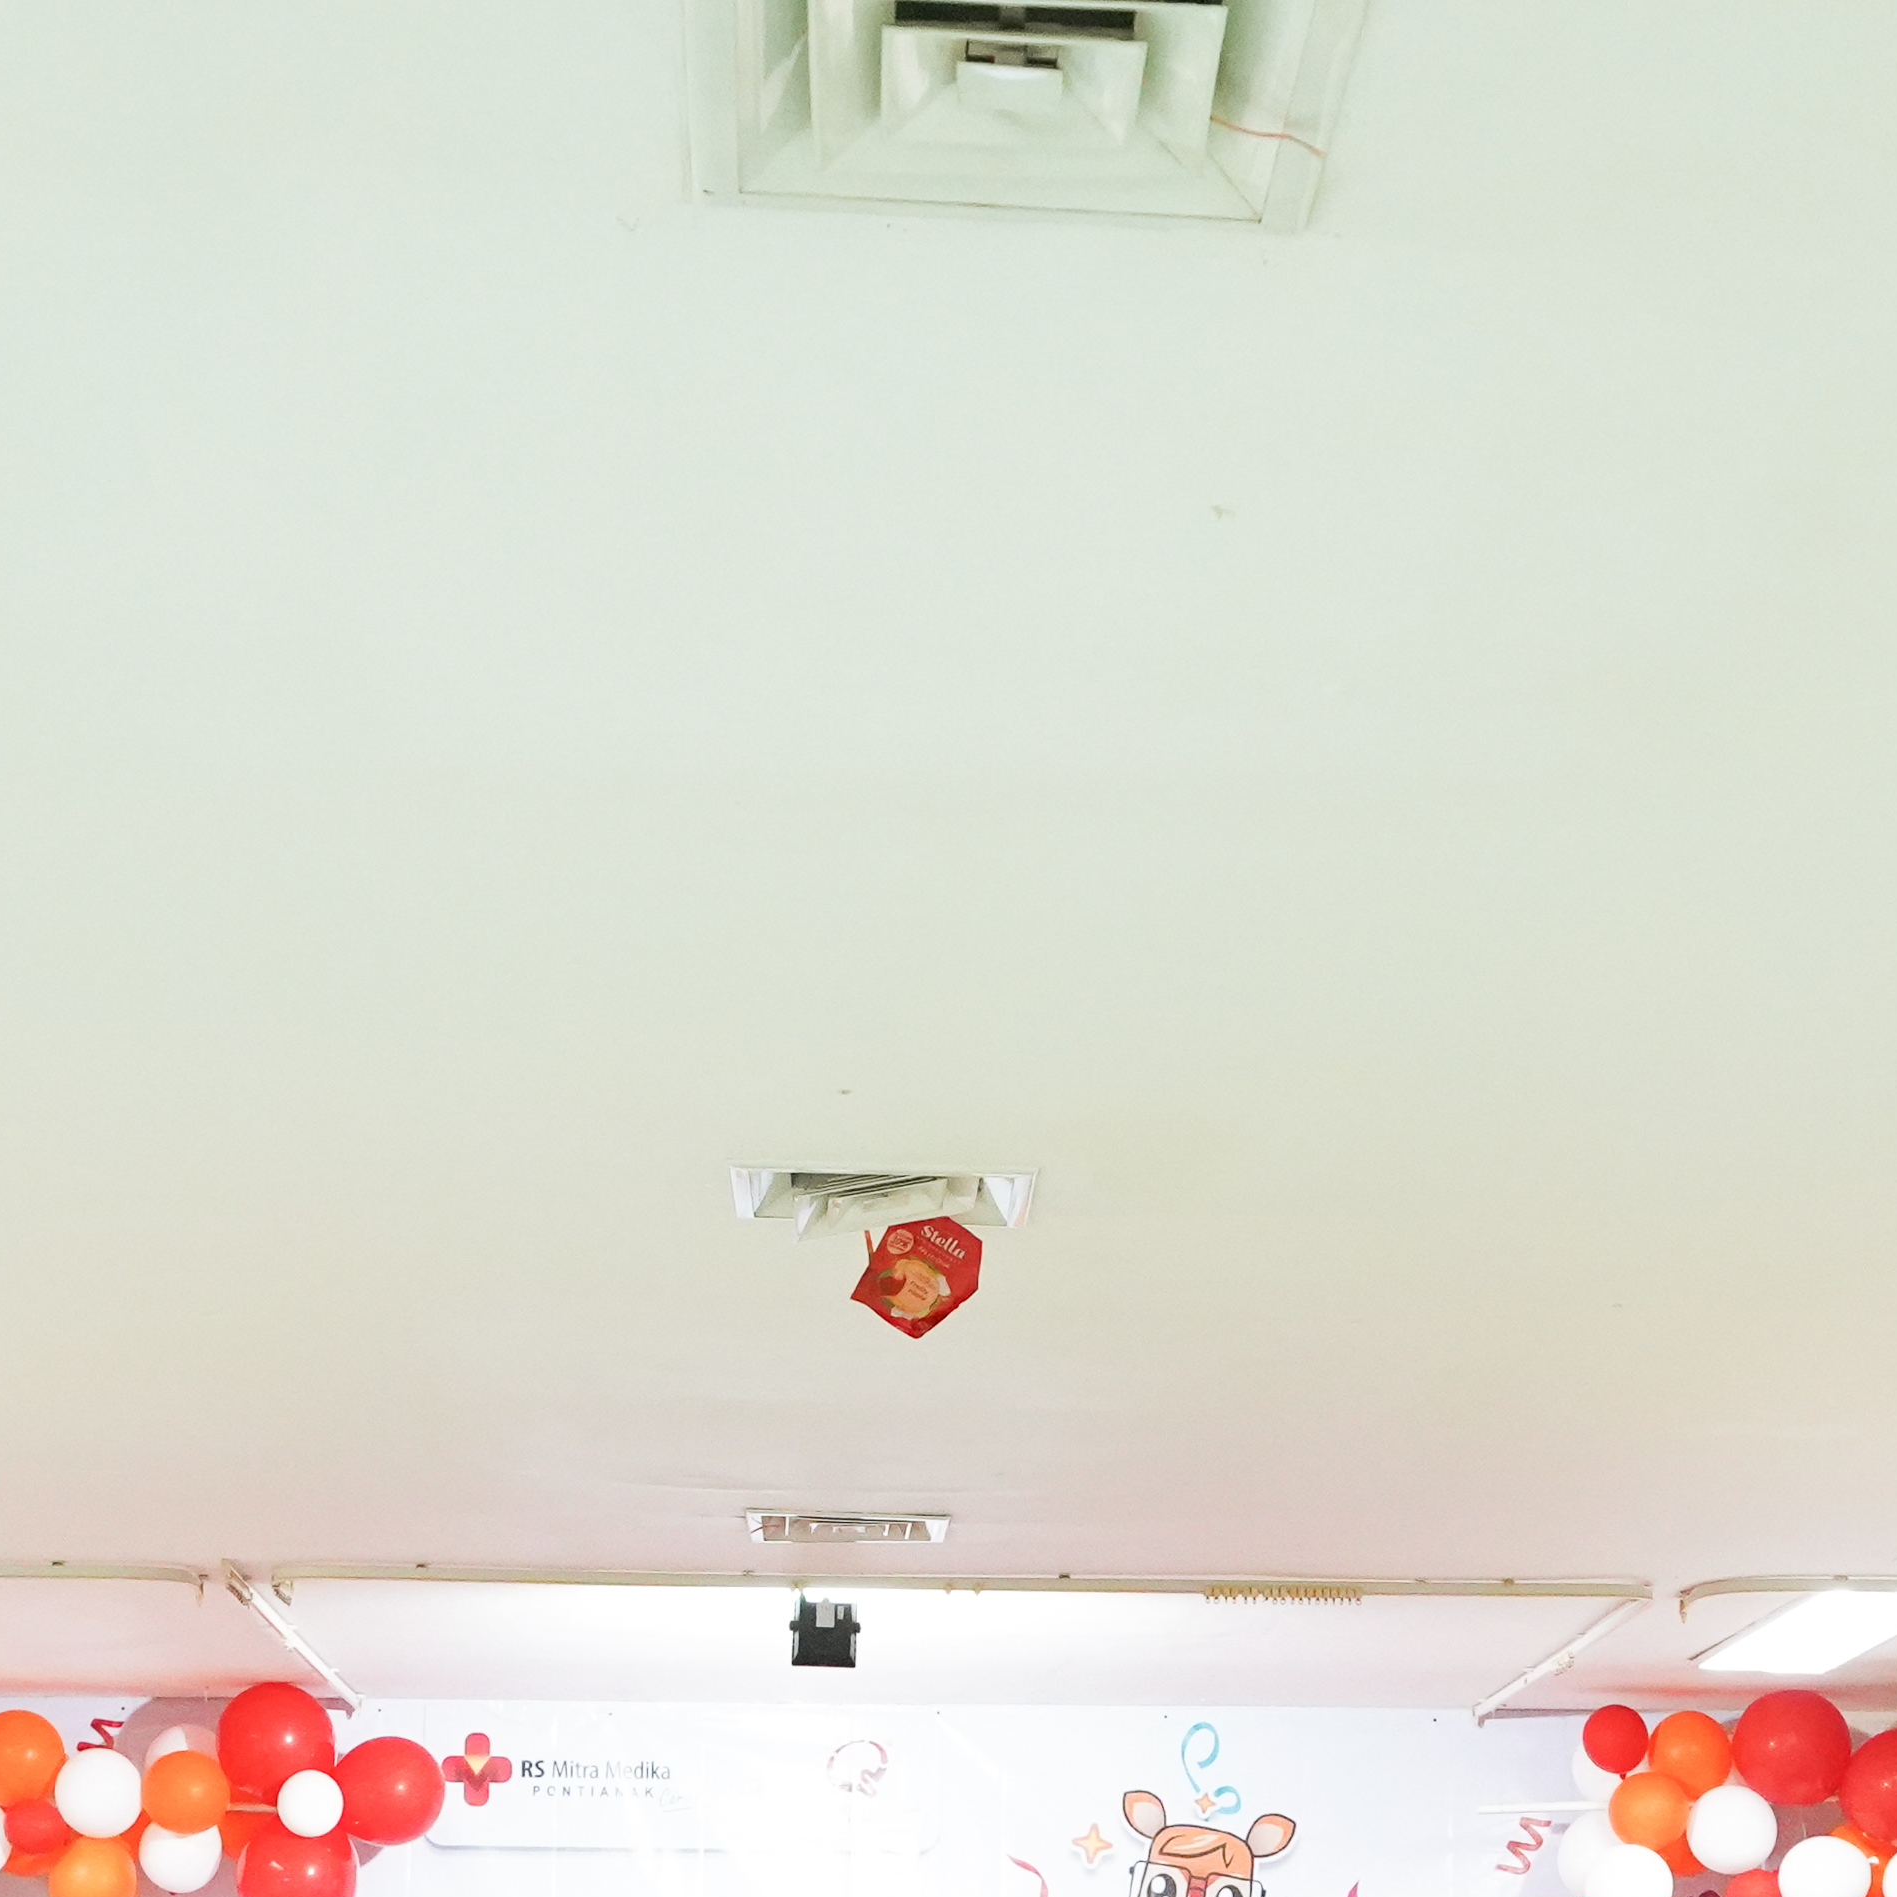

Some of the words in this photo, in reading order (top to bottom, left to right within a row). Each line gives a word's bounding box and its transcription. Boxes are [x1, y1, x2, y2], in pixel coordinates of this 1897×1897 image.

[921, 1225, 964, 1258] Stella
[521, 1760, 545, 1778] RS
[551, 1760, 599, 1780] Mitra
[604, 1760, 671, 1781] Medika
[532, 1785, 655, 1798] PONTIANAK
